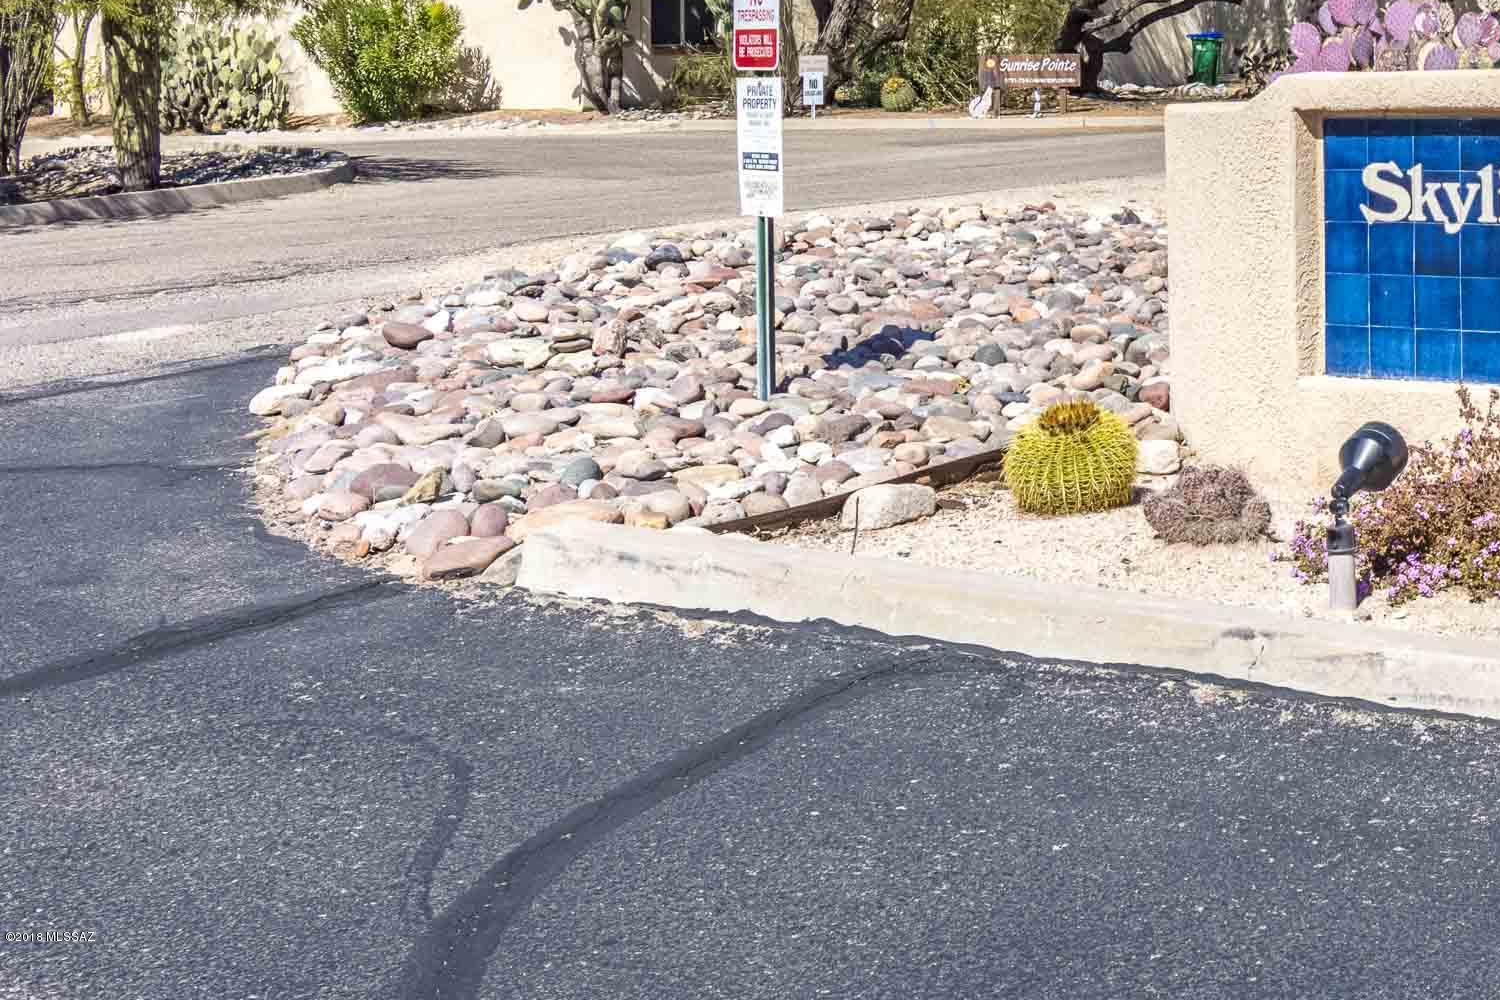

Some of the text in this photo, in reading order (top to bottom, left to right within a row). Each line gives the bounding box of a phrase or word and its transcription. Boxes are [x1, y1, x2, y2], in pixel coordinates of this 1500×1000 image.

[1000, 57, 1077, 72] Sunrise Pointe
[809, 79, 818, 89] NO
[747, 85, 773, 97] PRIVATE
[743, 97, 777, 110] PROPERTY
